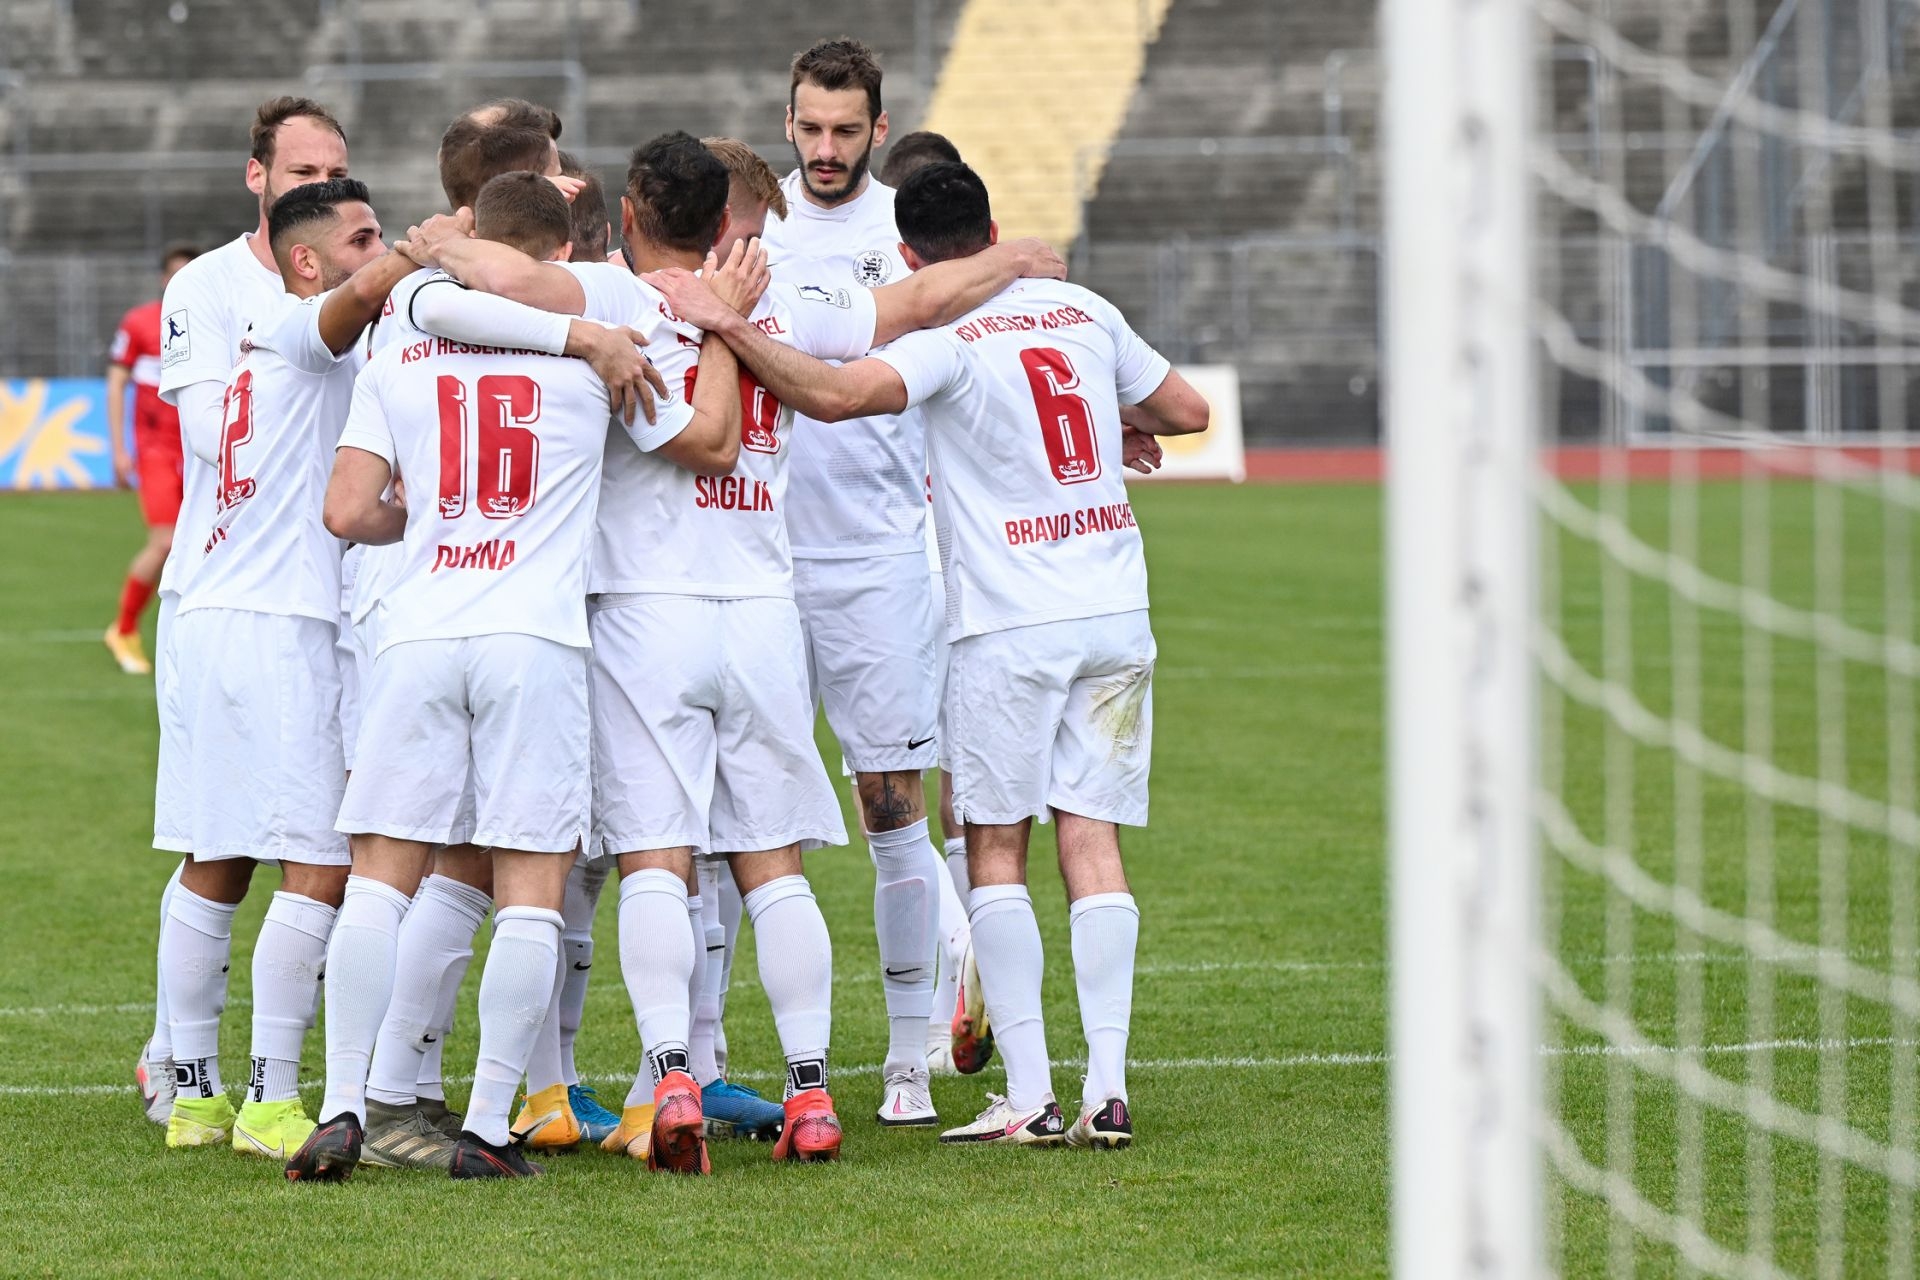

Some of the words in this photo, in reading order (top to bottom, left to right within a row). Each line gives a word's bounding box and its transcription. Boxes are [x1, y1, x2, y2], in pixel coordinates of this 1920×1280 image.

[401, 338, 432, 364] KSV
[1019, 347, 1101, 485] 6
[437, 375, 541, 519] 16
[695, 474, 774, 511] SAGLIK
[1005, 513, 1070, 545] BRAVO
